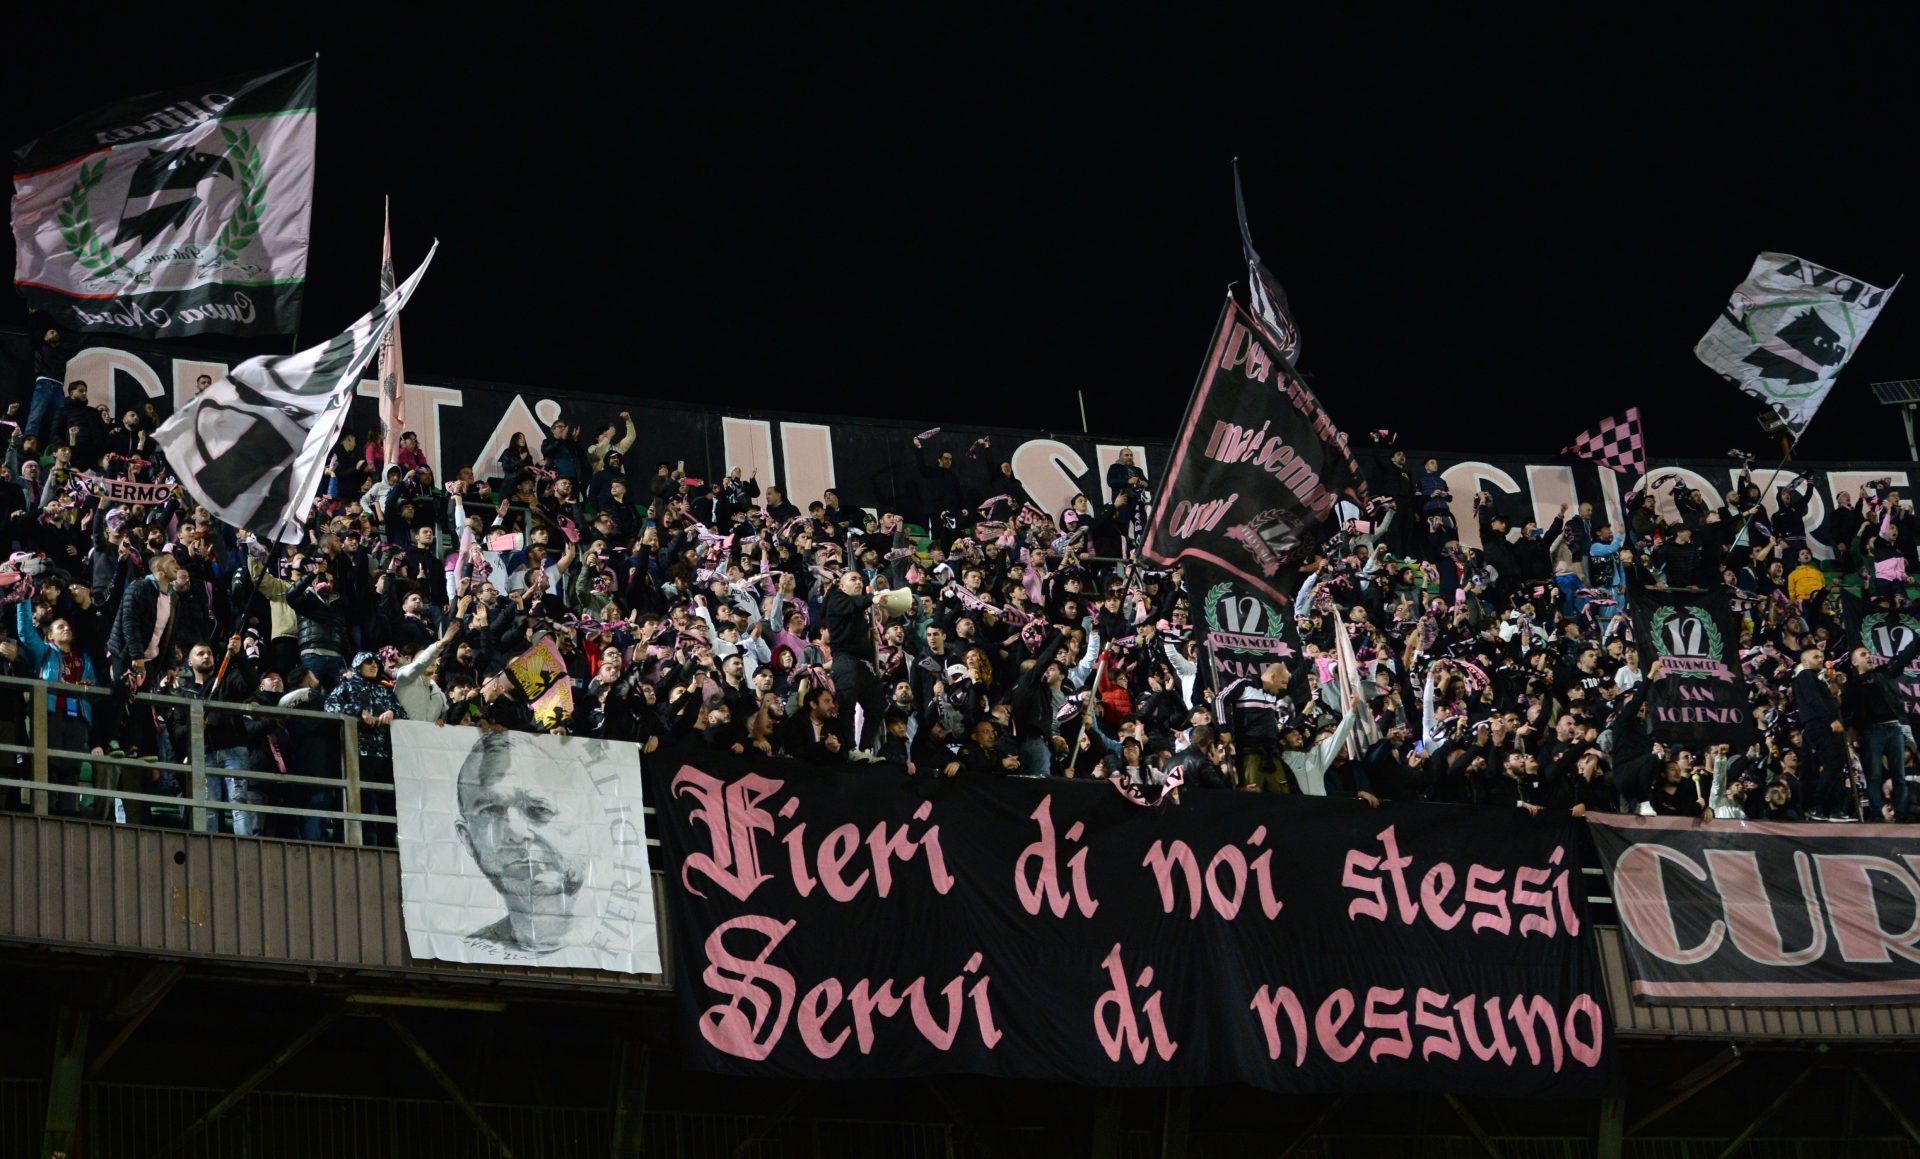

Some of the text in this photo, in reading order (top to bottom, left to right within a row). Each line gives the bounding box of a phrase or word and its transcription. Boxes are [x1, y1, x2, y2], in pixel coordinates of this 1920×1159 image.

[110, 483, 171, 502] ERMO
[1221, 595, 1264, 635] 12
[1664, 617, 1707, 656] 12
[1657, 706, 1744, 723] LORENZO
[1678, 685, 1715, 702] SAN
[604, 803, 640, 849] DI
[670, 764, 1581, 939] Fieri di noi stessi
[589, 861, 643, 960] FIERI
[1614, 843, 1920, 967] CUR
[698, 914, 1603, 1074] Servi di nessuno
